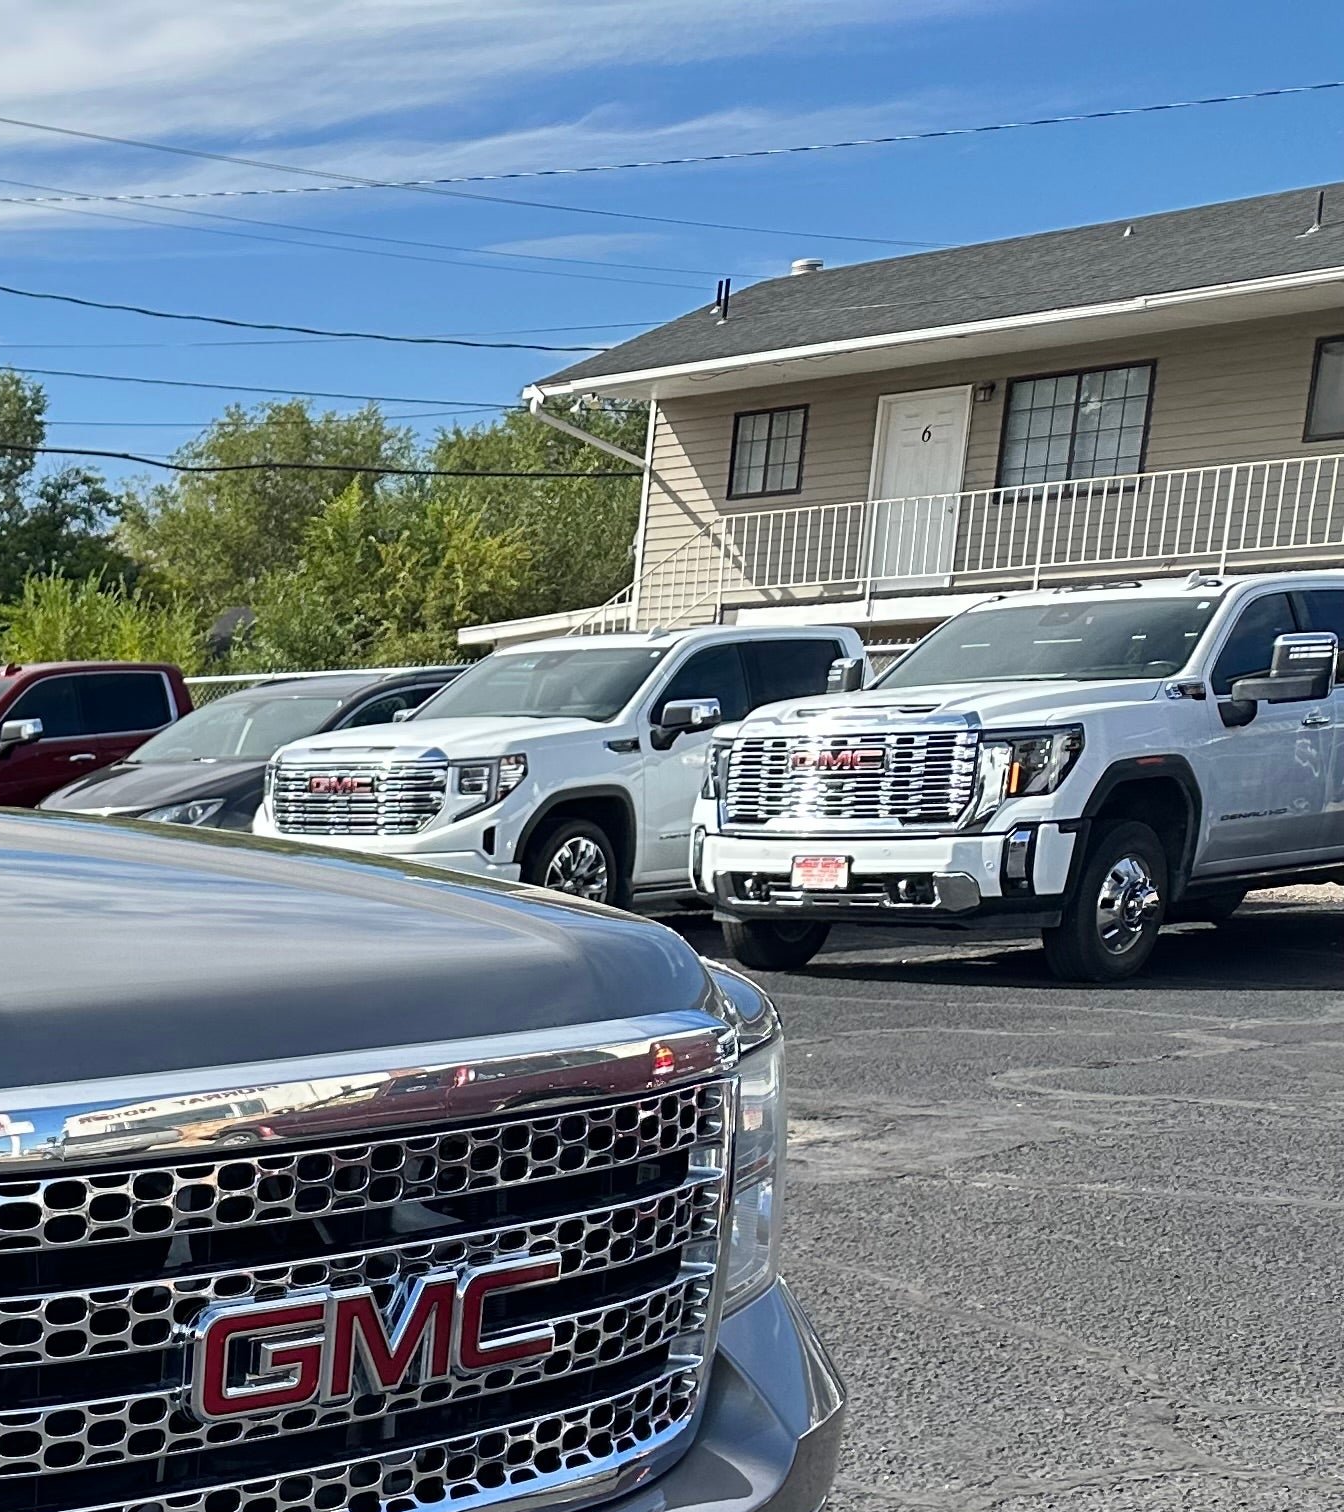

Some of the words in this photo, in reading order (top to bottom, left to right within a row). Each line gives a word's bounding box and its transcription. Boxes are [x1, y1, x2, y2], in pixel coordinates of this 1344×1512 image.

[922, 424, 932, 442] 6
[792, 749, 883, 770] GMC
[311, 777, 372, 793] GMC
[190, 1251, 563, 1423] GMC
